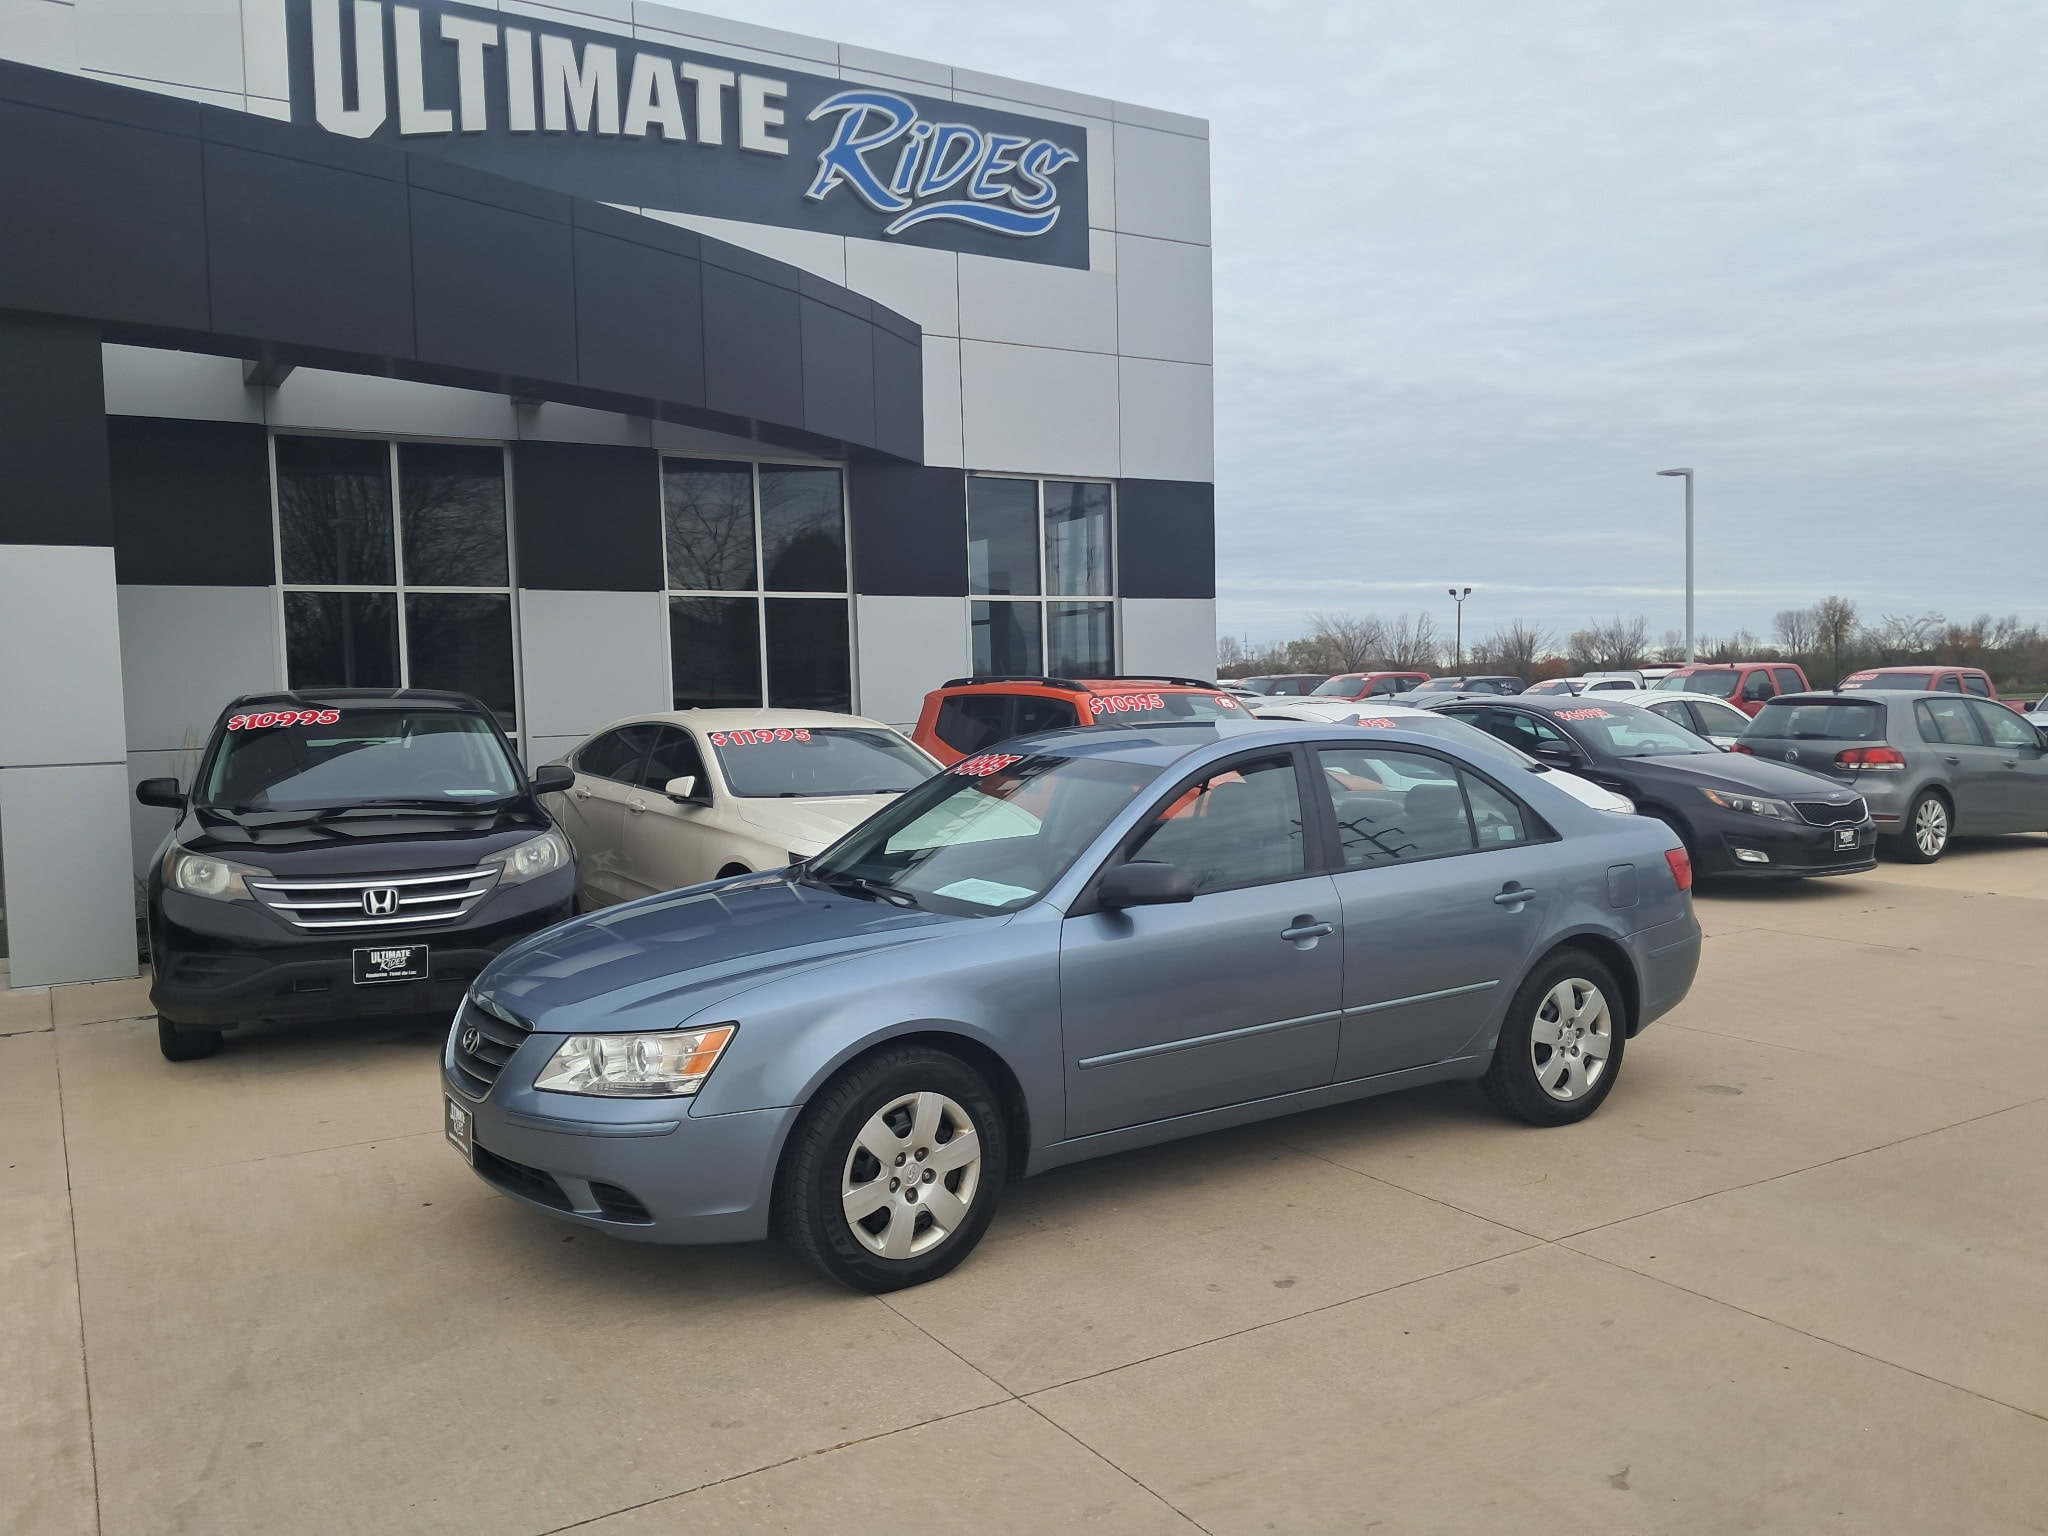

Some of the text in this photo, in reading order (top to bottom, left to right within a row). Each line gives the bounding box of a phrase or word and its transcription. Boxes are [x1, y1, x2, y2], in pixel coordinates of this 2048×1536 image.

[311, 0, 790, 156] ULTIMATE
[1089, 693, 1165, 714] $10995
[227, 709, 341, 731] $10995
[710, 728, 811, 747] $11995
[370, 949, 412, 964] ULTIMATE
